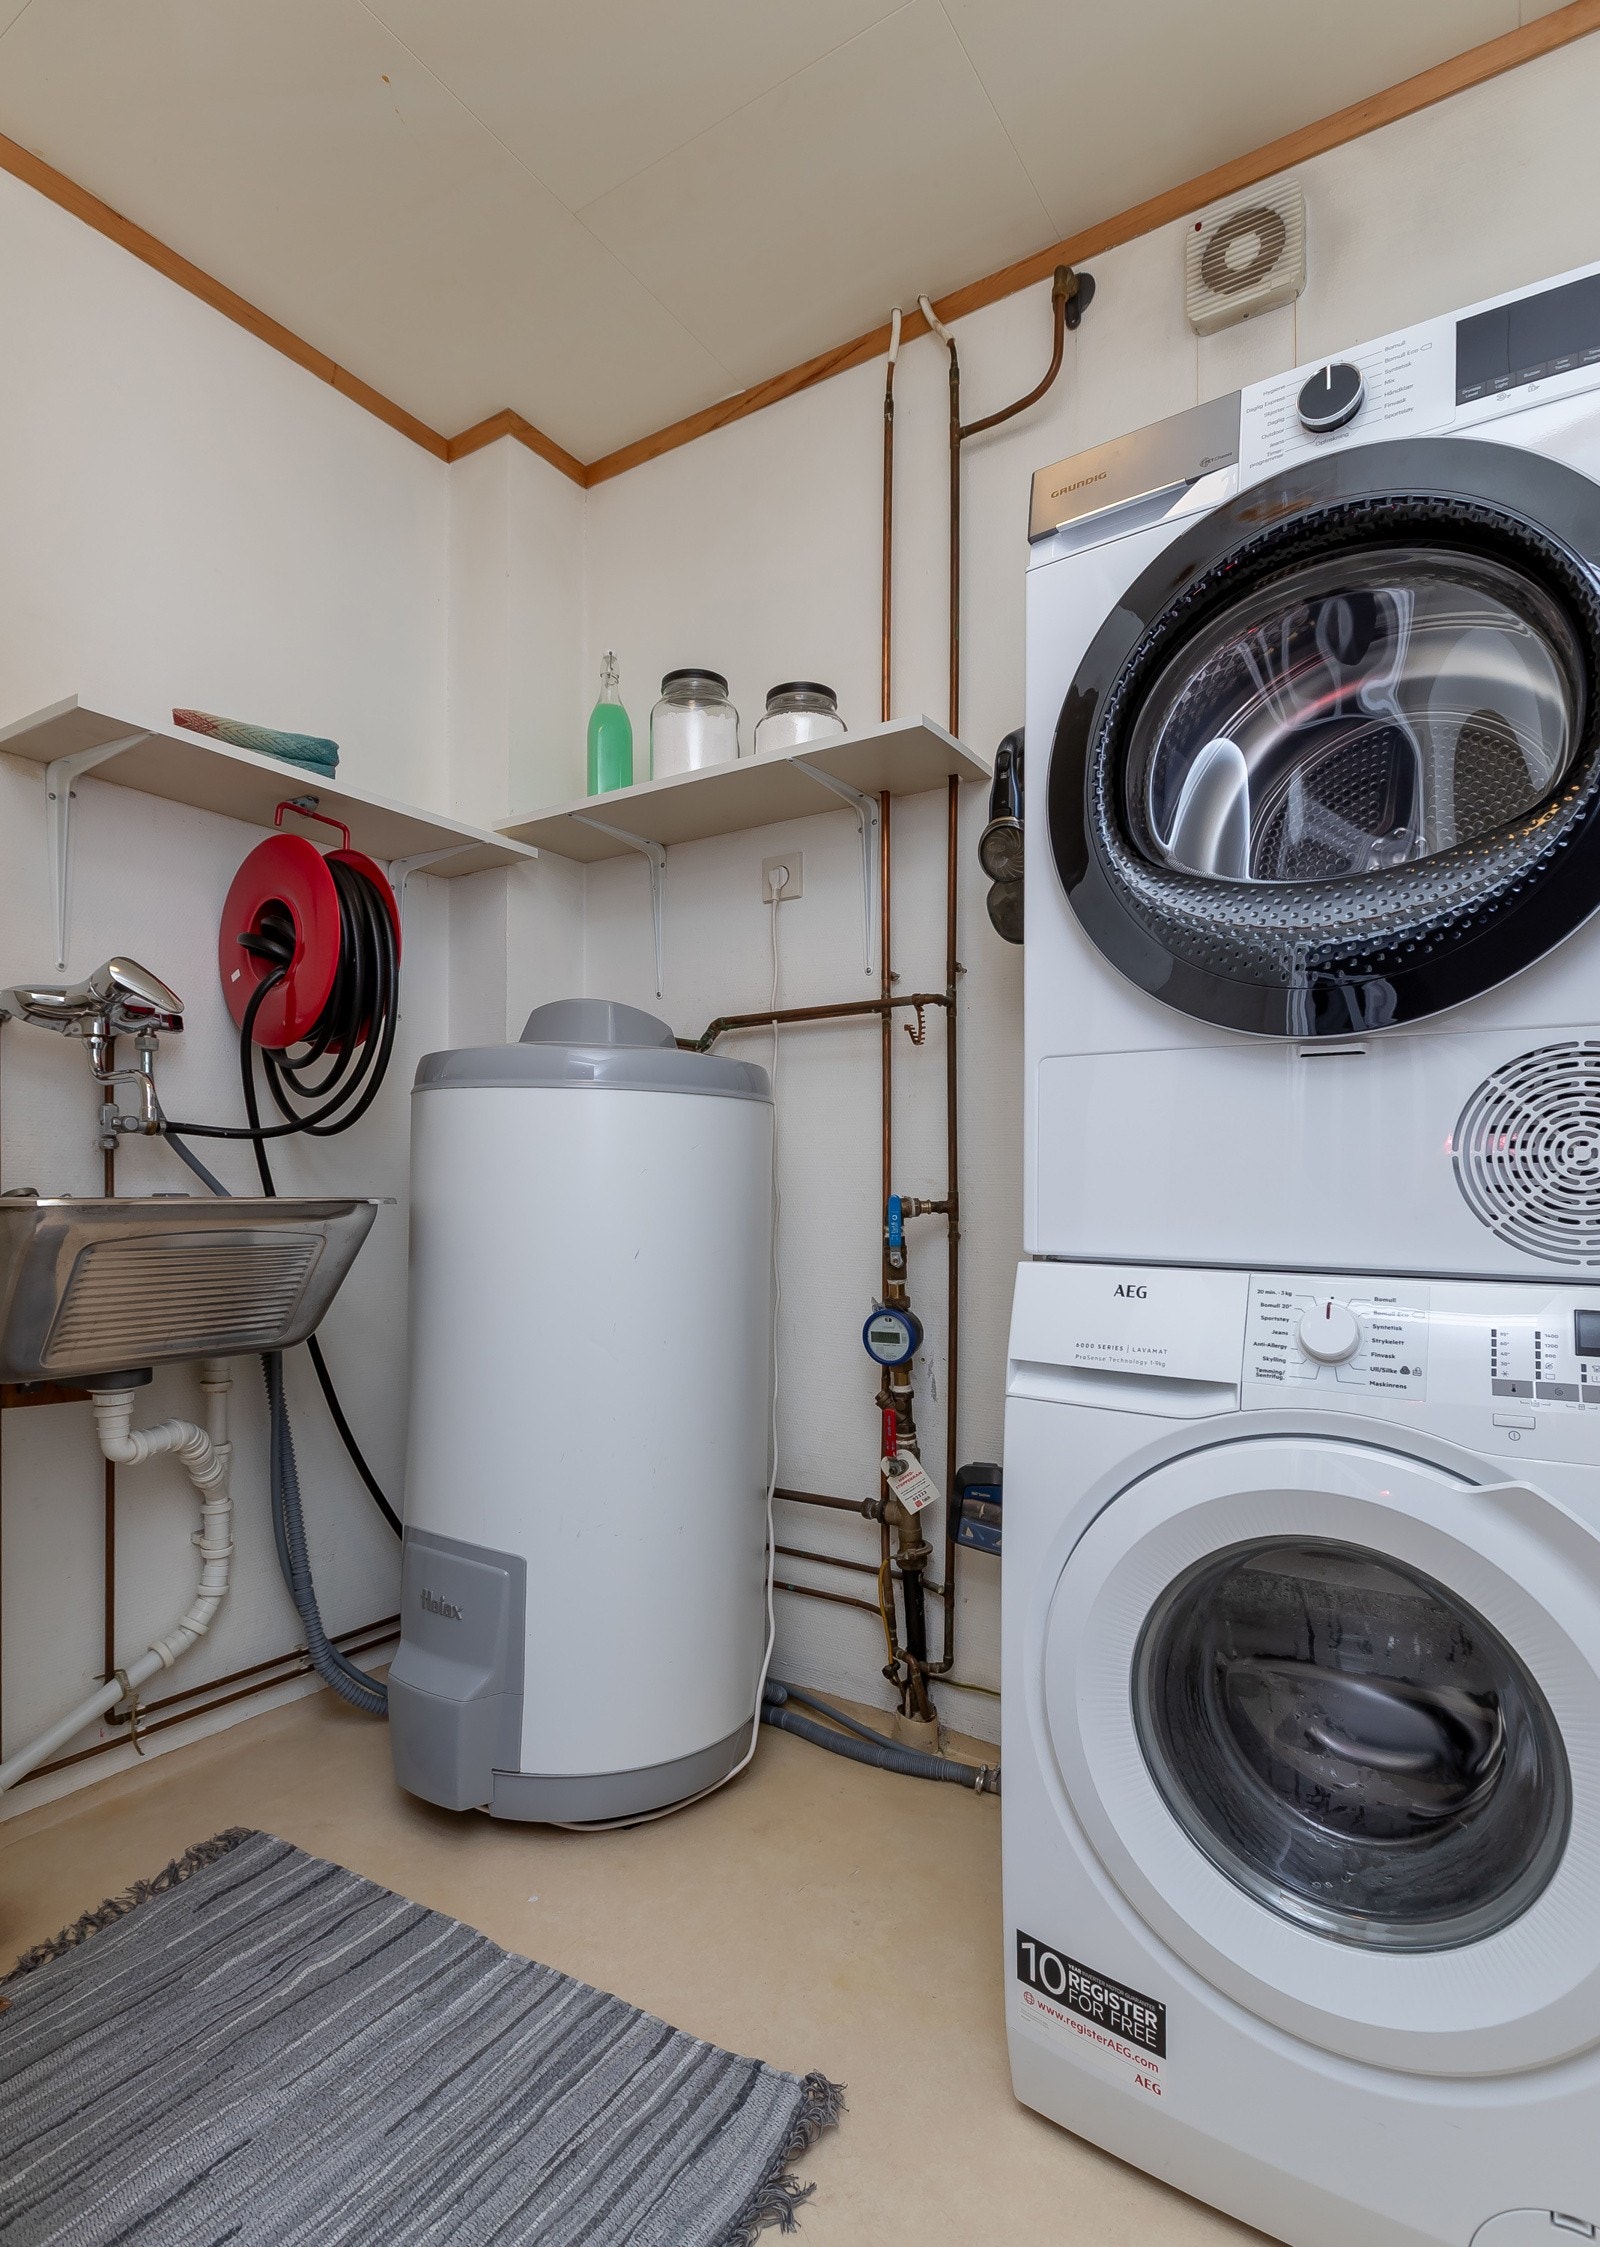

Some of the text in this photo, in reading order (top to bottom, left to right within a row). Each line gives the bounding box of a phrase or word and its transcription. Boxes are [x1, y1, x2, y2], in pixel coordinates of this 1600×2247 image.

[1050, 471, 1107, 499] GRUNDIG
[1113, 1284, 1147, 1299] AEG
[1372, 1323, 1403, 1331] Syntetisk
[1132, 1347, 1168, 1355] LAVAMAT
[1253, 1341, 1288, 1350] Anti-Allergy
[1075, 1354, 1106, 1362] ProSense
[1108, 1356, 1148, 1366] Technology
[1262, 1356, 1287, 1364] Skylling
[1370, 1351, 1396, 1359] Finvask
[1369, 1366, 1398, 1374] Ull/Silke
[1369, 1380, 1407, 1390] Maskinrens
[1021, 1942, 1067, 1996] 10
[1068, 1971, 1158, 2030] REGISTER
[1068, 1987, 1104, 2021] FOR
[1110, 2009, 1157, 2048] FREE
[1037, 1999, 1160, 2073] www.registerAEG.com
[1134, 2073, 1162, 2096] AEG
